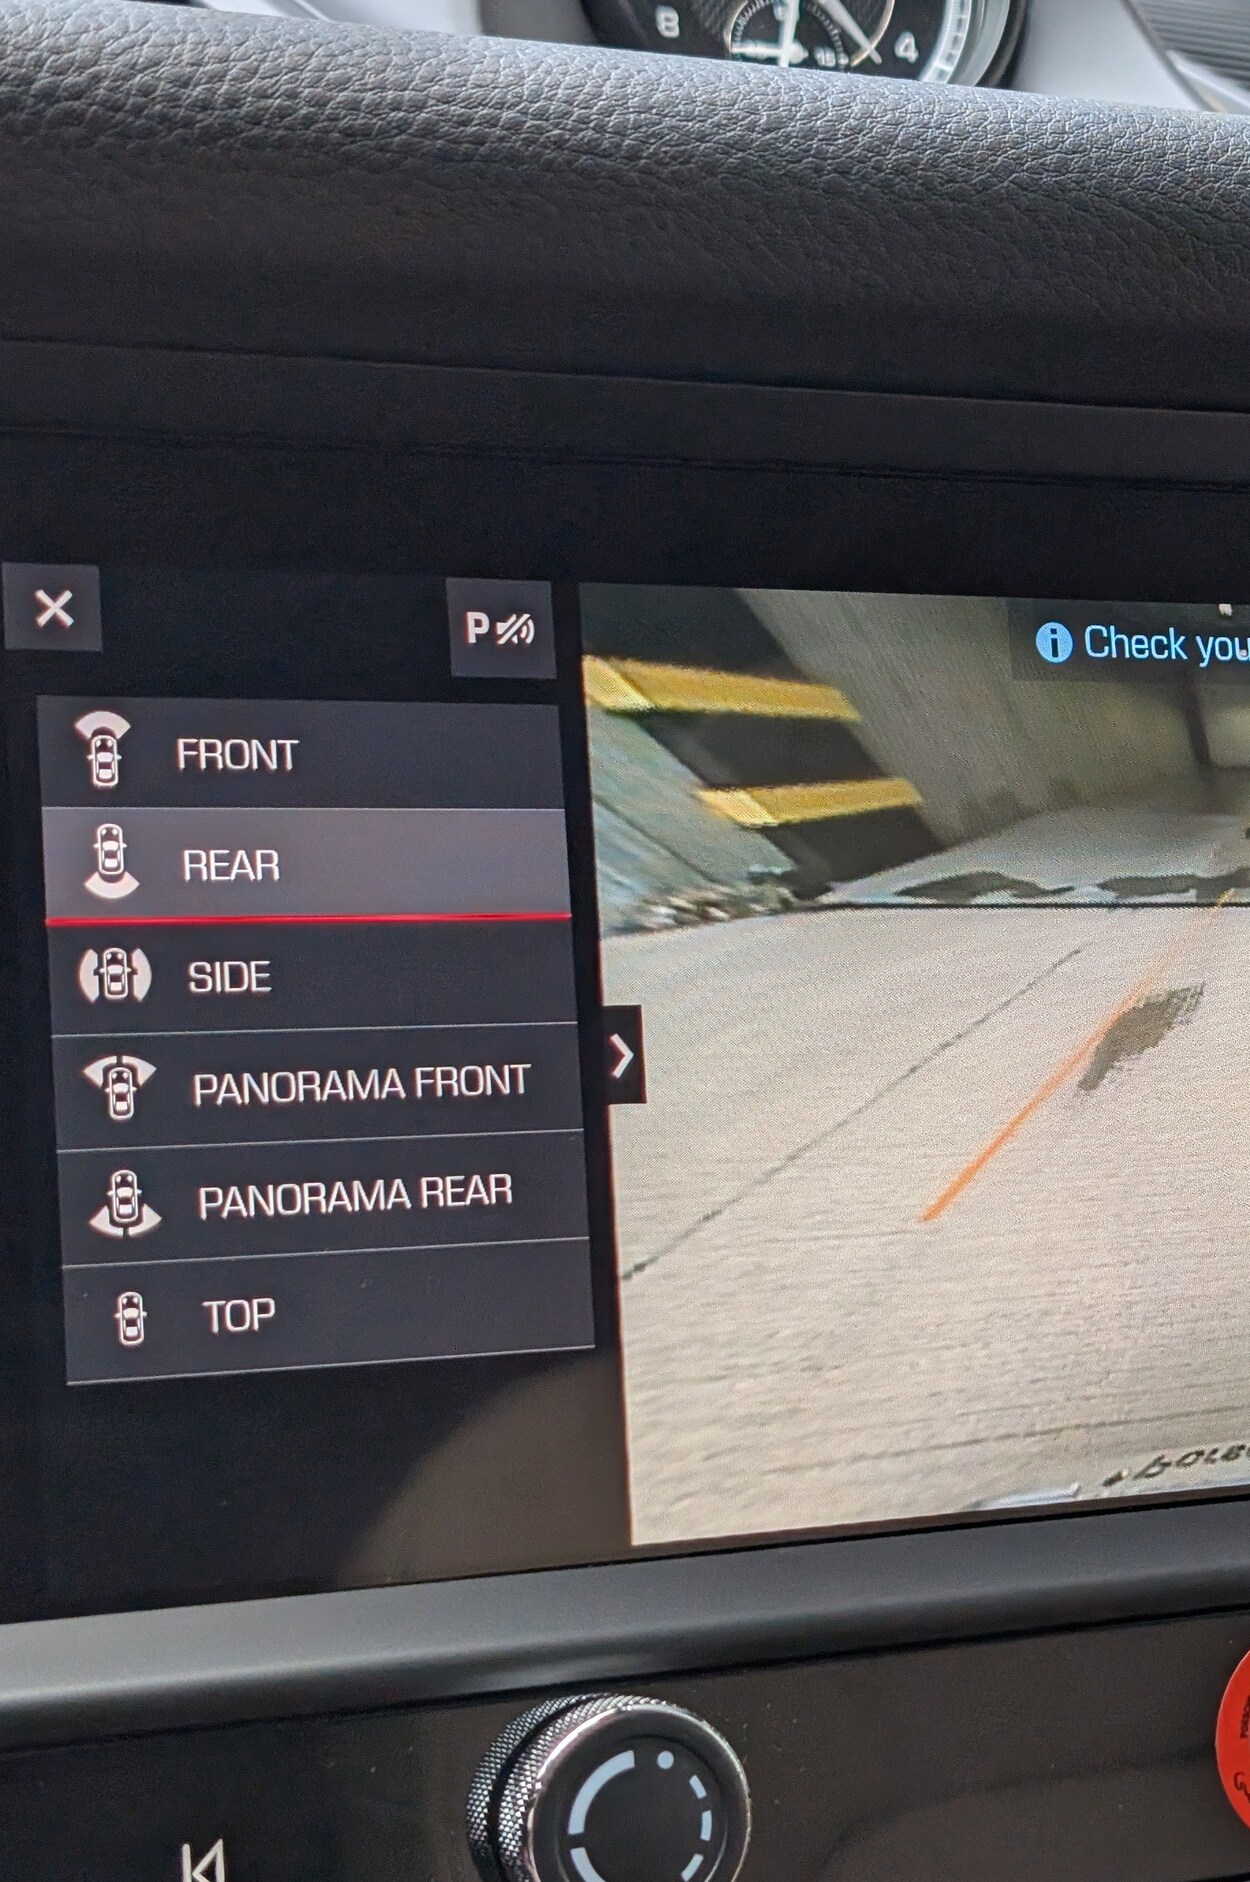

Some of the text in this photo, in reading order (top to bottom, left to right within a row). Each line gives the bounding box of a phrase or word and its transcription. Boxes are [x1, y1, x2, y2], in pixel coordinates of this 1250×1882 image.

[655, 5, 680, 38] 8
[894, 31, 919, 64] 4
[467, 612, 490, 644] P
[1085, 625, 1188, 660] Check
[177, 738, 299, 771] FRONT
[184, 850, 280, 882] REAR
[189, 960, 272, 993] SIDE
[193, 1064, 532, 1106] PANORAMA FRONT
[200, 1173, 513, 1220] PANORAMA REAR
[202, 1297, 276, 1334] TOP
